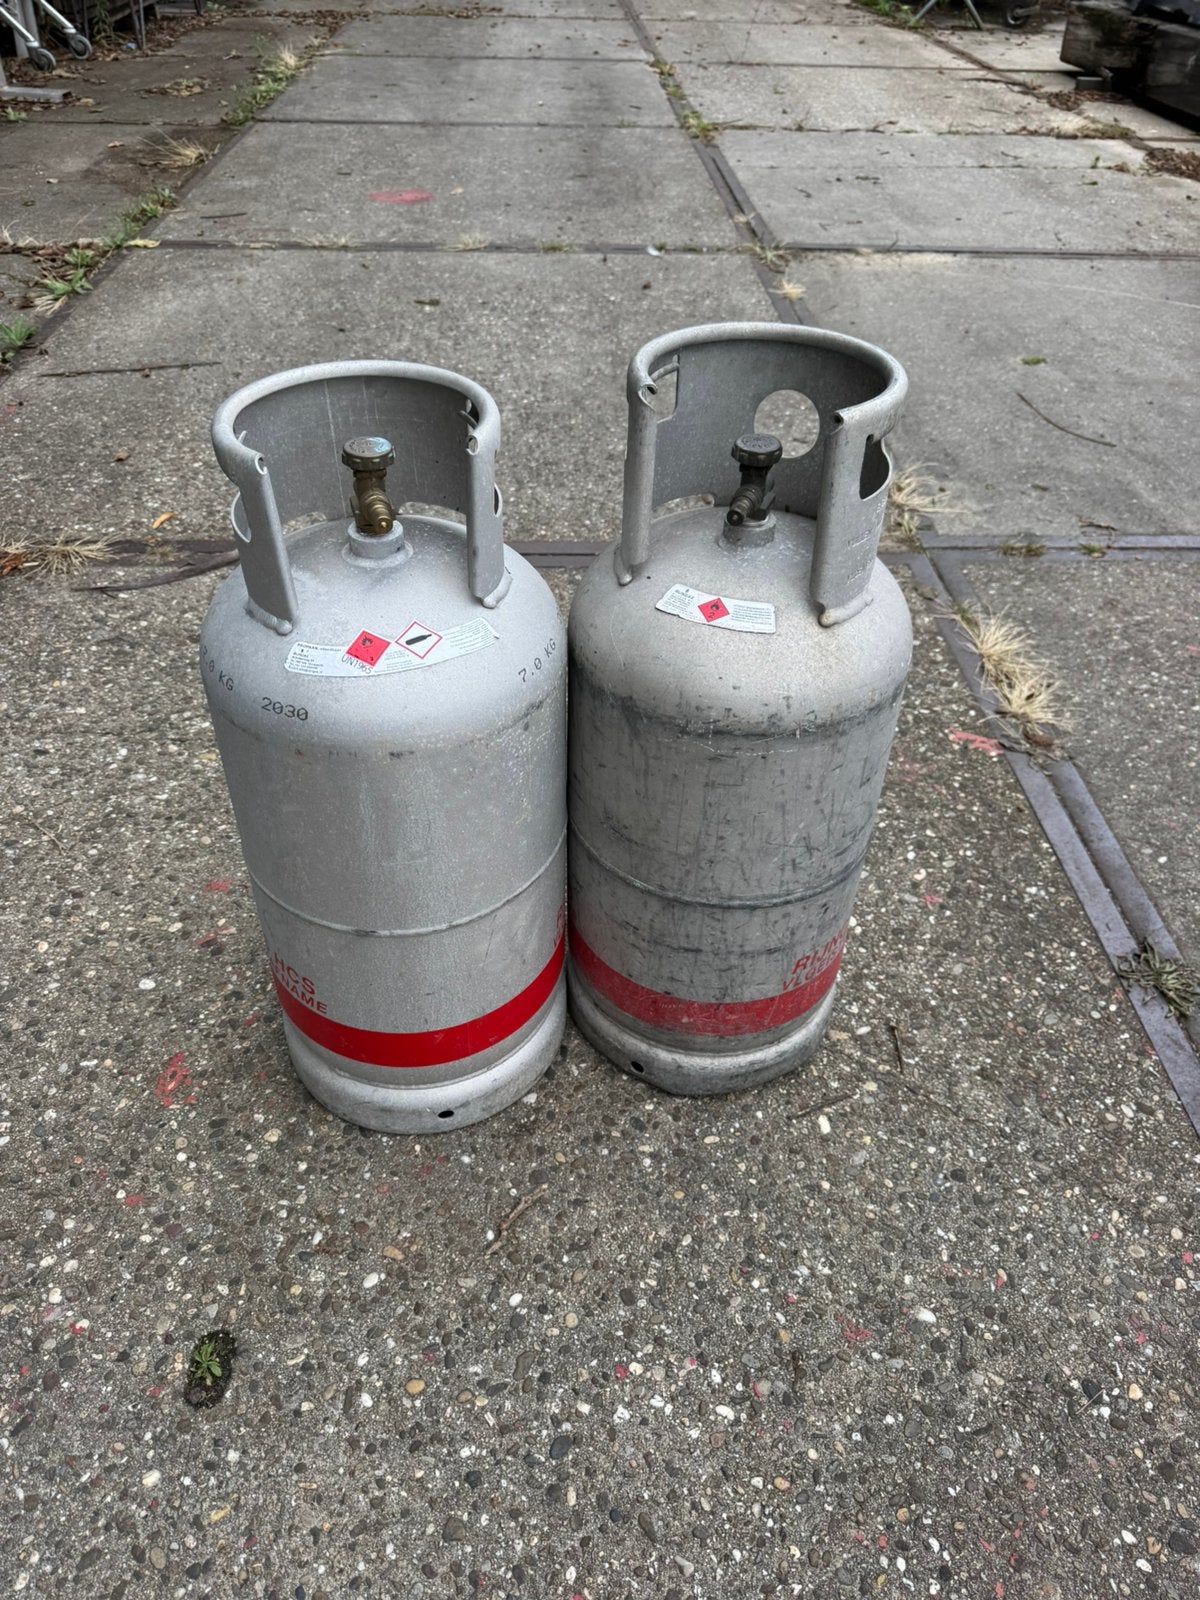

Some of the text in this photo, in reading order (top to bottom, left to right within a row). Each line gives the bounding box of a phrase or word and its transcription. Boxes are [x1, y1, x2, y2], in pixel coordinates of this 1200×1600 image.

[341, 654, 374, 674] UN1965
[518, 638, 556, 683] 7.0 KG
[219, 670, 234, 691] KG
[261, 697, 309, 721] 2030
